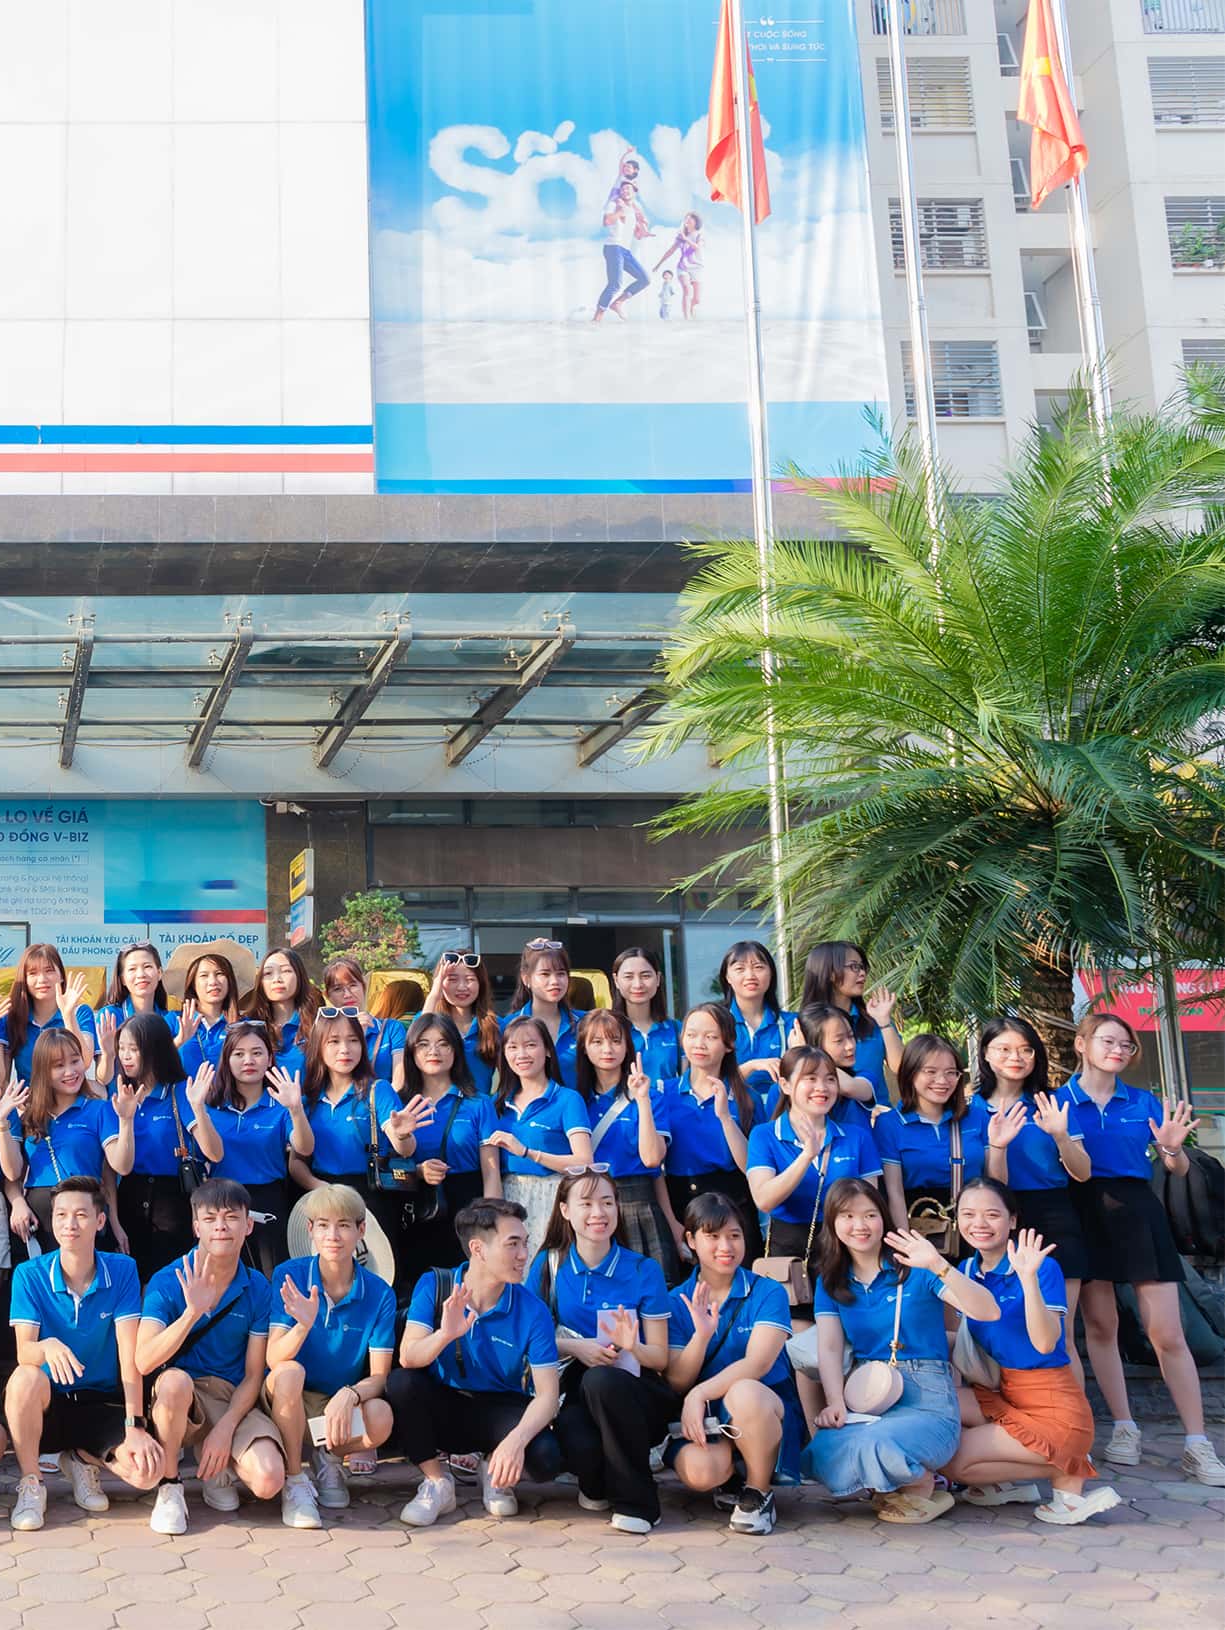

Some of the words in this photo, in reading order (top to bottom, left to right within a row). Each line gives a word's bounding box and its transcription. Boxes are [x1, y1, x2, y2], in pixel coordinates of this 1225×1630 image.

[6, 809, 28, 824] LO
[58, 806, 89, 823] GIÁ
[53, 831, 89, 842] V-BIZ
[159, 932, 175, 944] TÀI
[238, 934, 259, 946] ĐẸP
